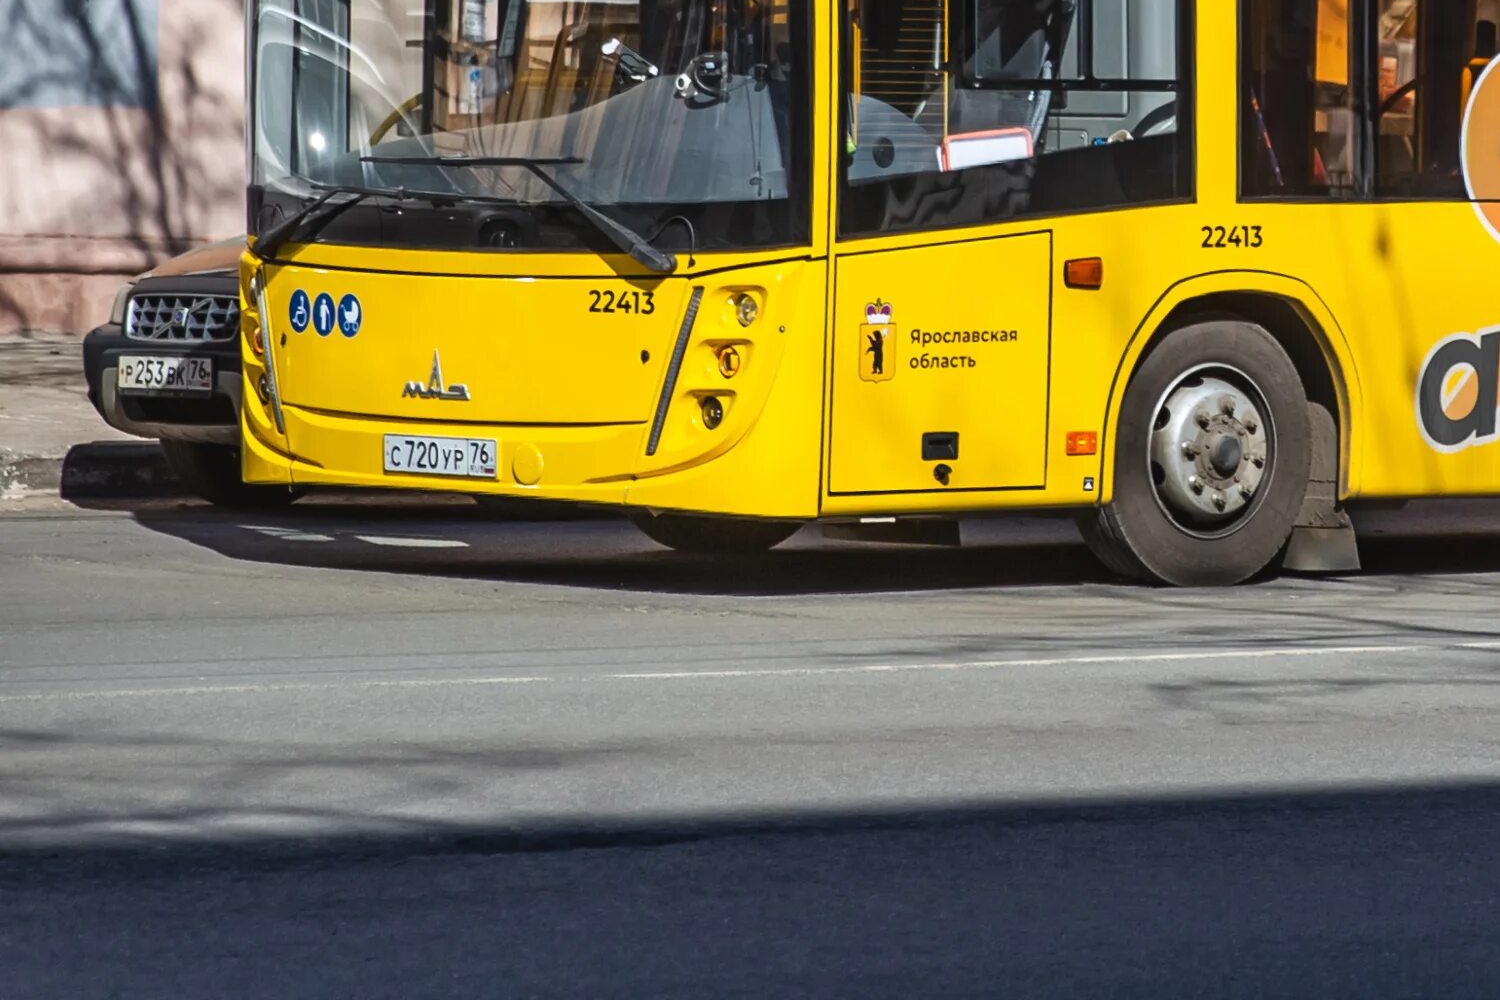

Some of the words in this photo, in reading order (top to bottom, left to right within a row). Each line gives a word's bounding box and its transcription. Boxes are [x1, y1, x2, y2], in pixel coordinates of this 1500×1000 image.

[1200, 225, 1263, 248] 22413
[588, 289, 656, 316] 22413
[910, 328, 1018, 348] Ярославская
[190, 359, 207, 380] 76
[909, 352, 977, 369] область
[470, 442, 489, 465] 76
